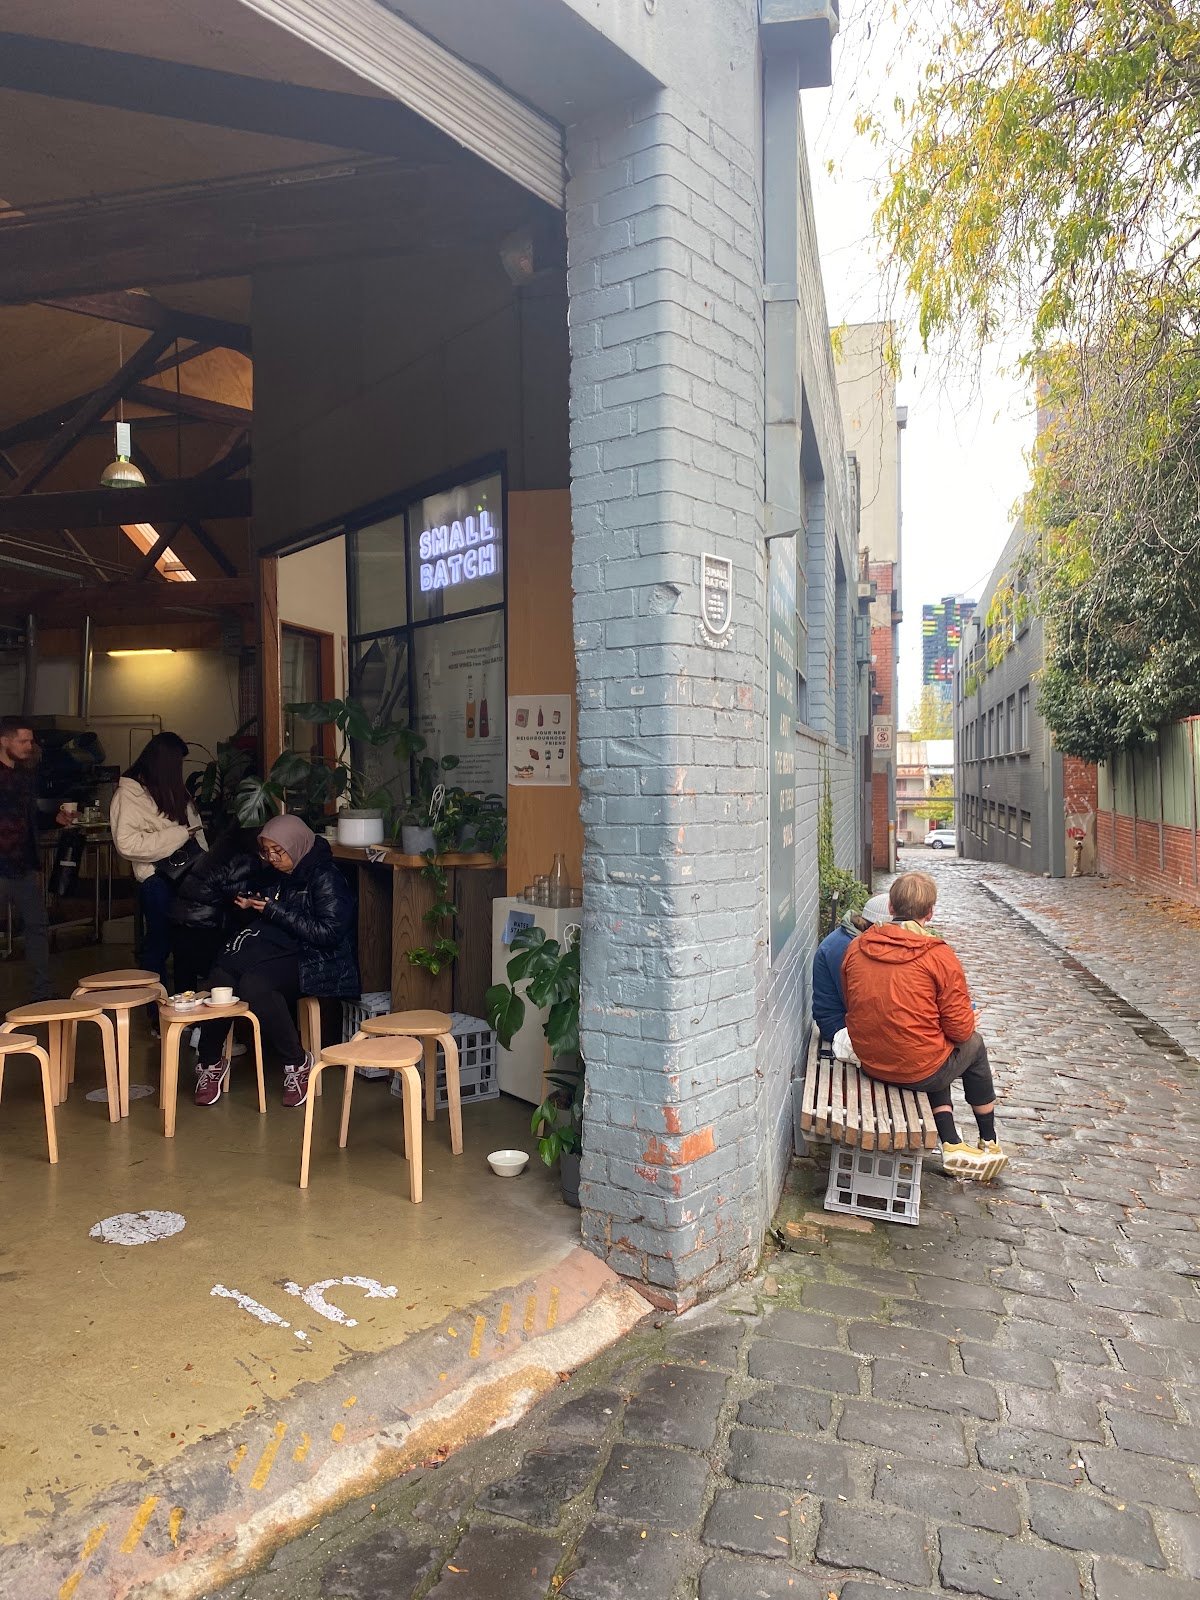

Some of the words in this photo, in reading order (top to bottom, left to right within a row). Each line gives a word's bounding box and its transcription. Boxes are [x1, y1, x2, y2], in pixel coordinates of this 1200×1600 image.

[419, 510, 495, 560] SMALL
[420, 543, 496, 592] BATCH
[705, 566, 728, 579] SMALL
[705, 576, 730, 589] BATCH
